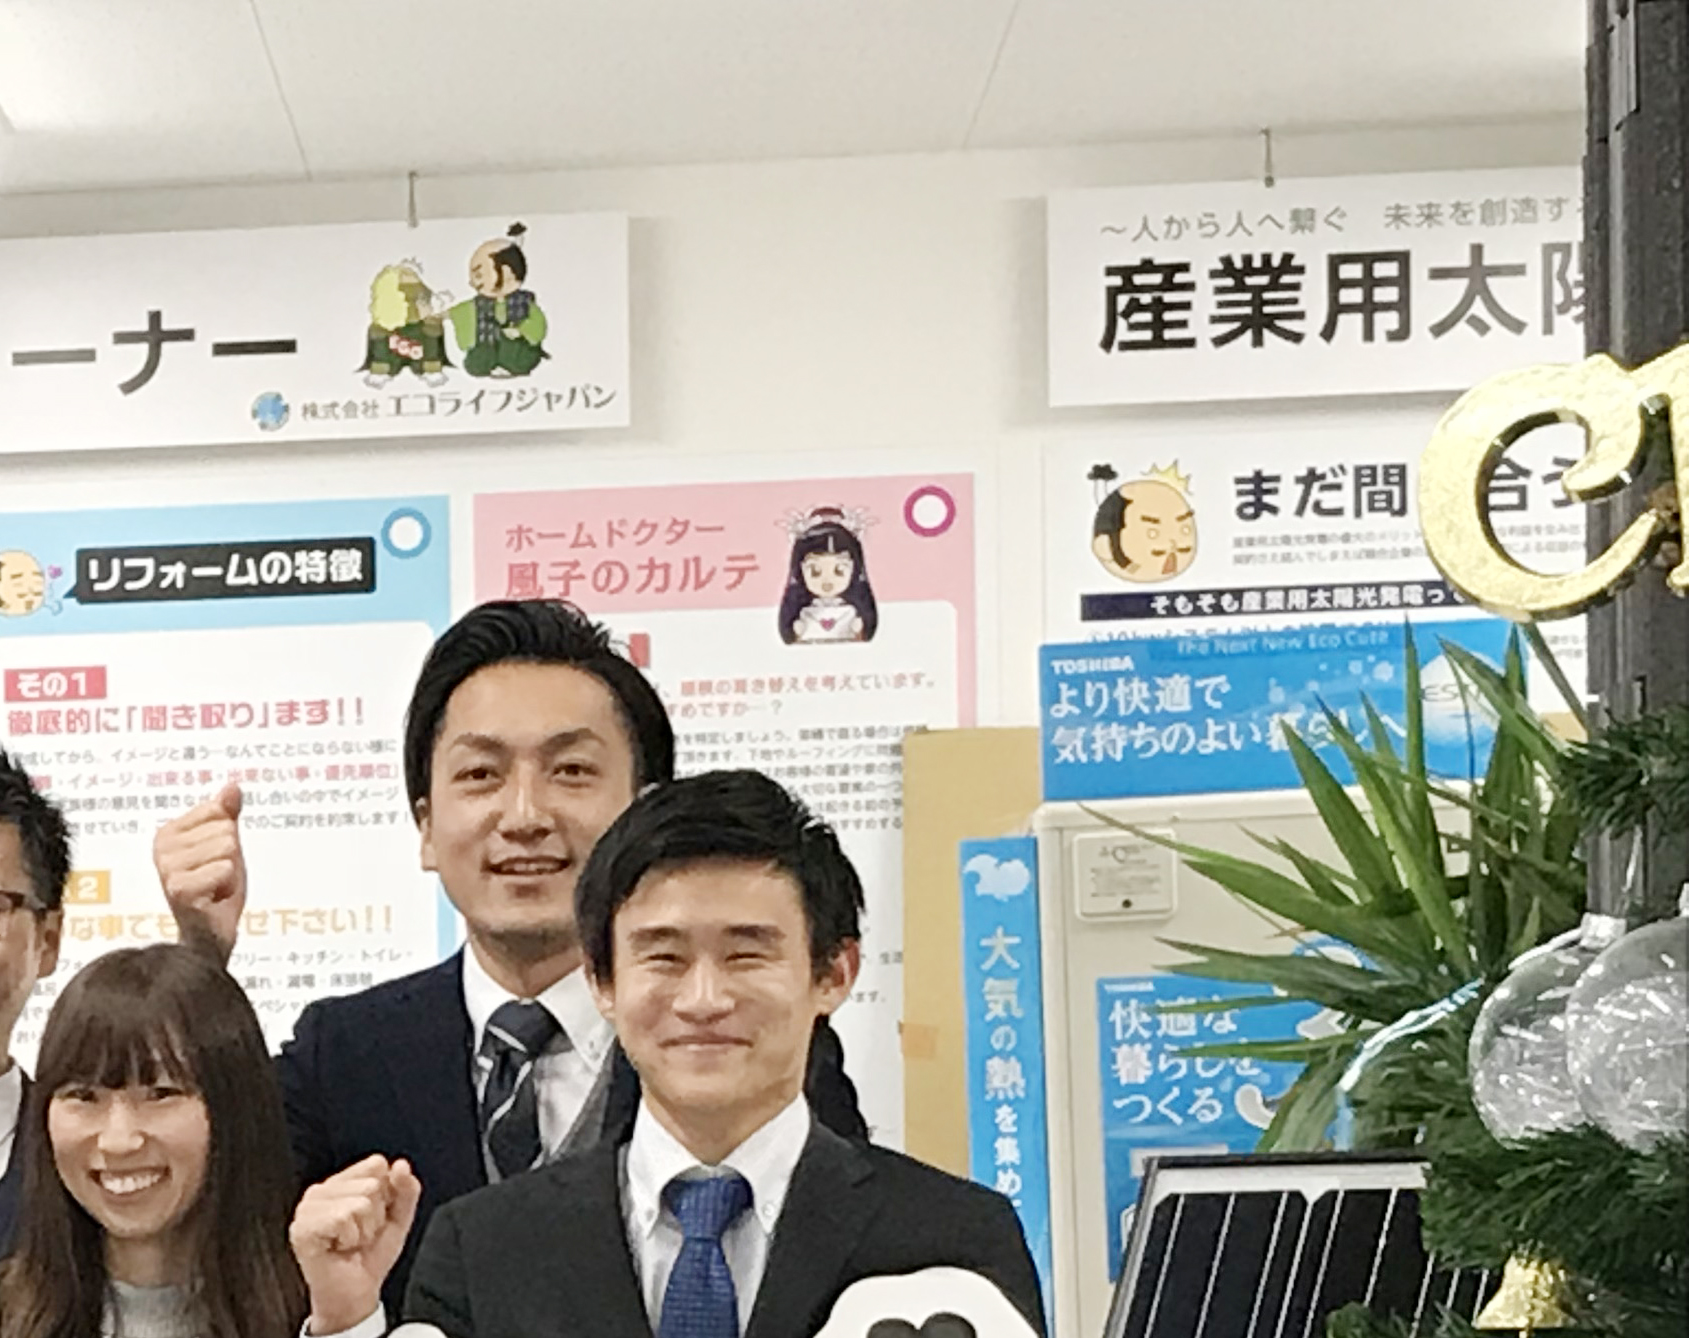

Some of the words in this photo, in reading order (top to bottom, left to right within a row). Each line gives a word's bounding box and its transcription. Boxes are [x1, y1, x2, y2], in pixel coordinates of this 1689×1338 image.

[1383, 193, 1585, 230] 未来を創造す
[301, 402, 380, 423] 株式会社
[387, 384, 617, 418] エコライフジャパン
[504, 520, 725, 552] ホームドクター
[88, 550, 363, 592] リフォームの特徴
[504, 552, 760, 599] 風子のカルテ
[1051, 655, 1134, 675] TOSHIBA
[17, 672, 88, 698] その1
[1050, 675, 1230, 718] より快適で
[1112, 1086, 1224, 1126] つくる
